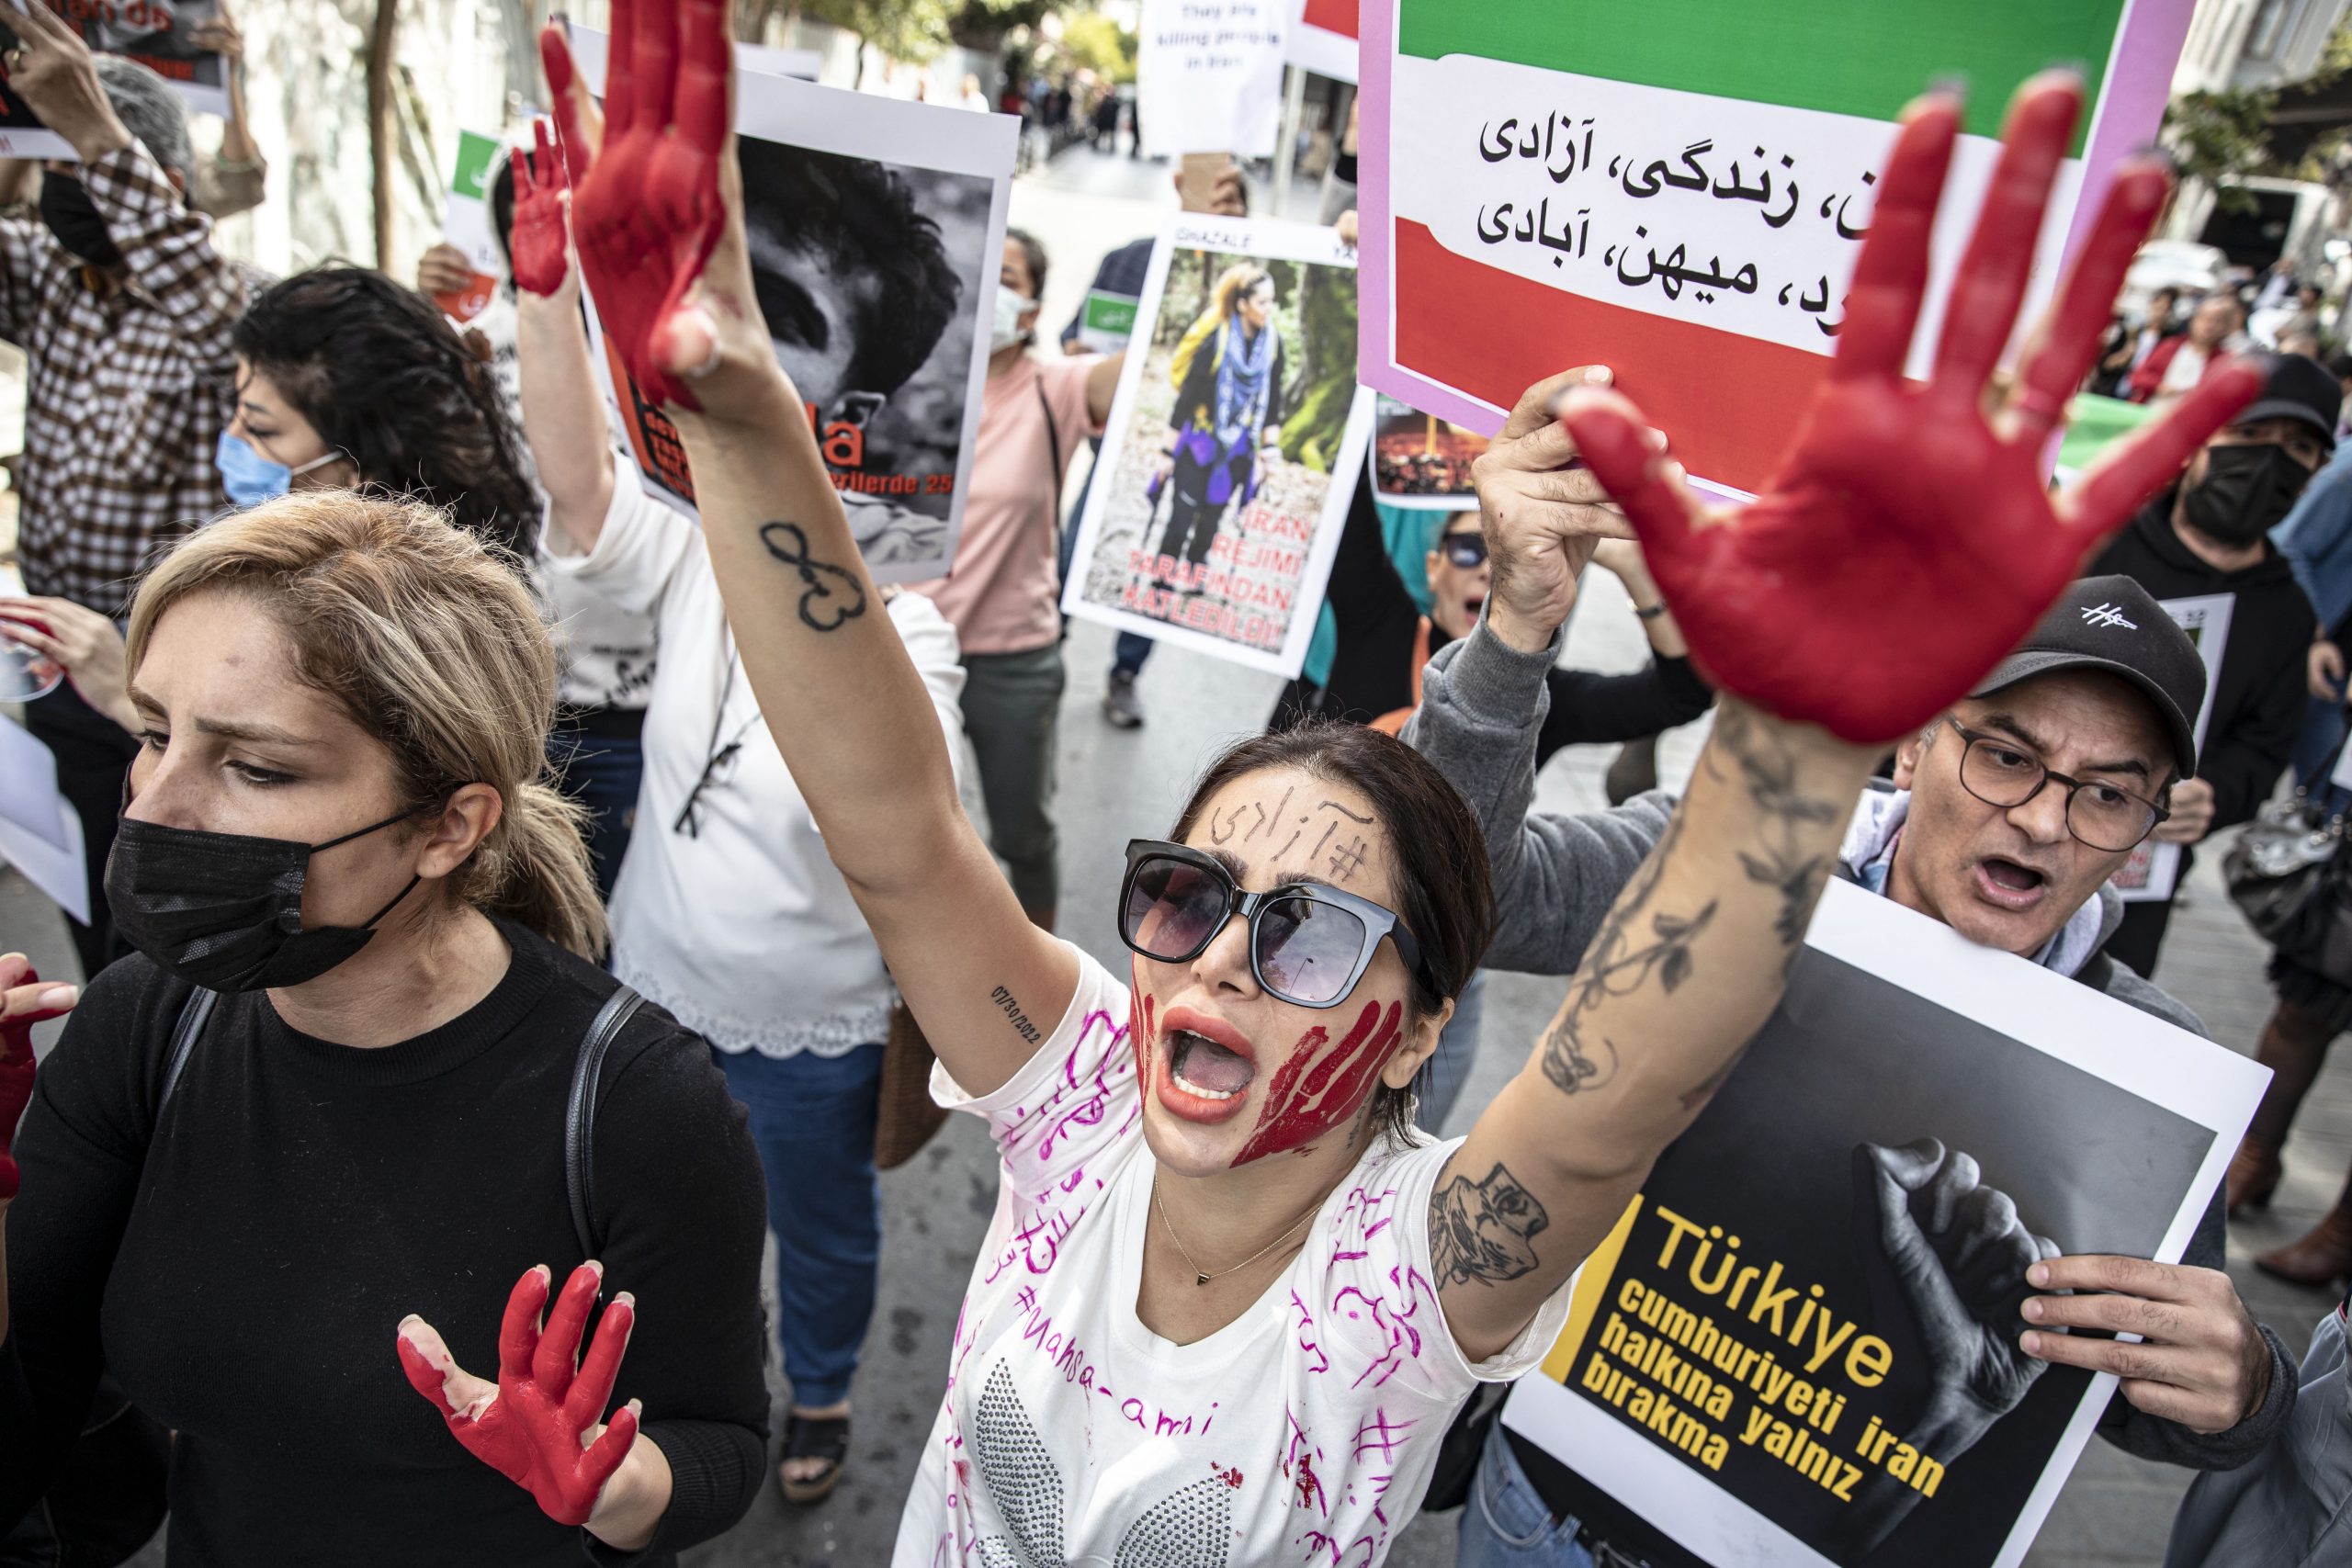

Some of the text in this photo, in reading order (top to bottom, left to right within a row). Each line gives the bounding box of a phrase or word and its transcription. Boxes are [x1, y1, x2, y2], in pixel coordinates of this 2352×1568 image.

[1479, 108, 1596, 185] آزادی
[1477, 196, 1591, 269] آبادی
[1127, 548, 1293, 612] TARAFINDAN
[991, 986, 1042, 1044] 07/30/2022
[1656, 1205, 1894, 1389] Türkiye
[1581, 1351, 1731, 1472] bırakma
[1599, 1312, 1864, 1503] halkına yalnız
[1618, 1278, 1946, 1499] cumhuriyeti iran
